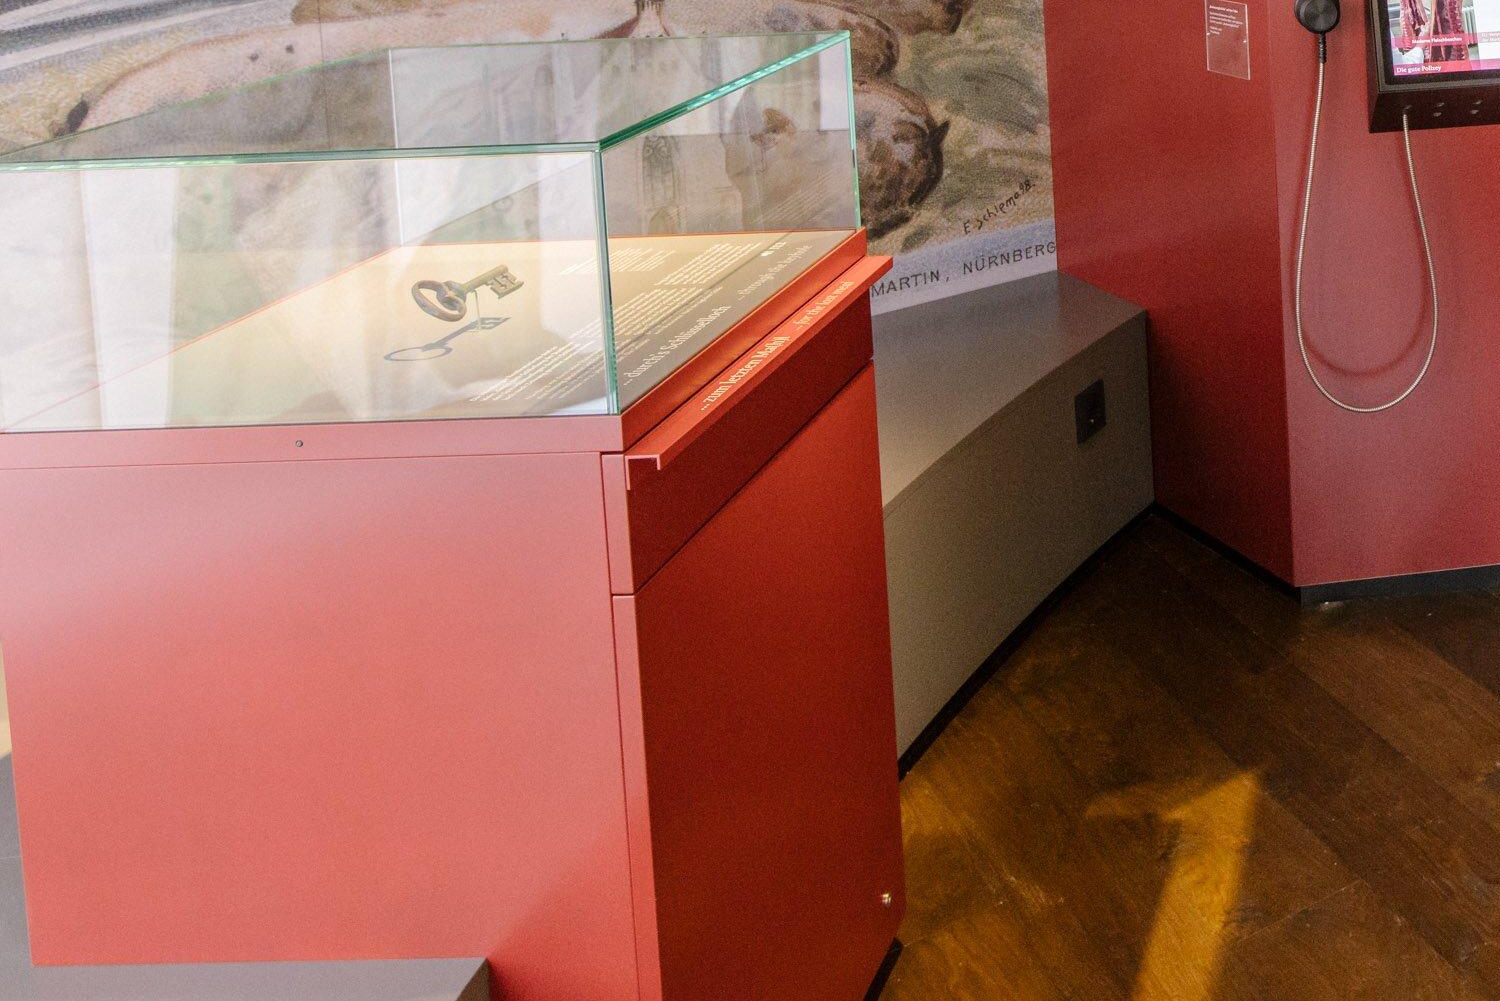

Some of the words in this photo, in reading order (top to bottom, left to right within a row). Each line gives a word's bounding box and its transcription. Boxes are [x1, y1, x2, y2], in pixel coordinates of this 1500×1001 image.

[962, 241, 1056, 276] NÜRNBERG
[703, 385, 732, 403] zum
[726, 353, 764, 385] letzten
